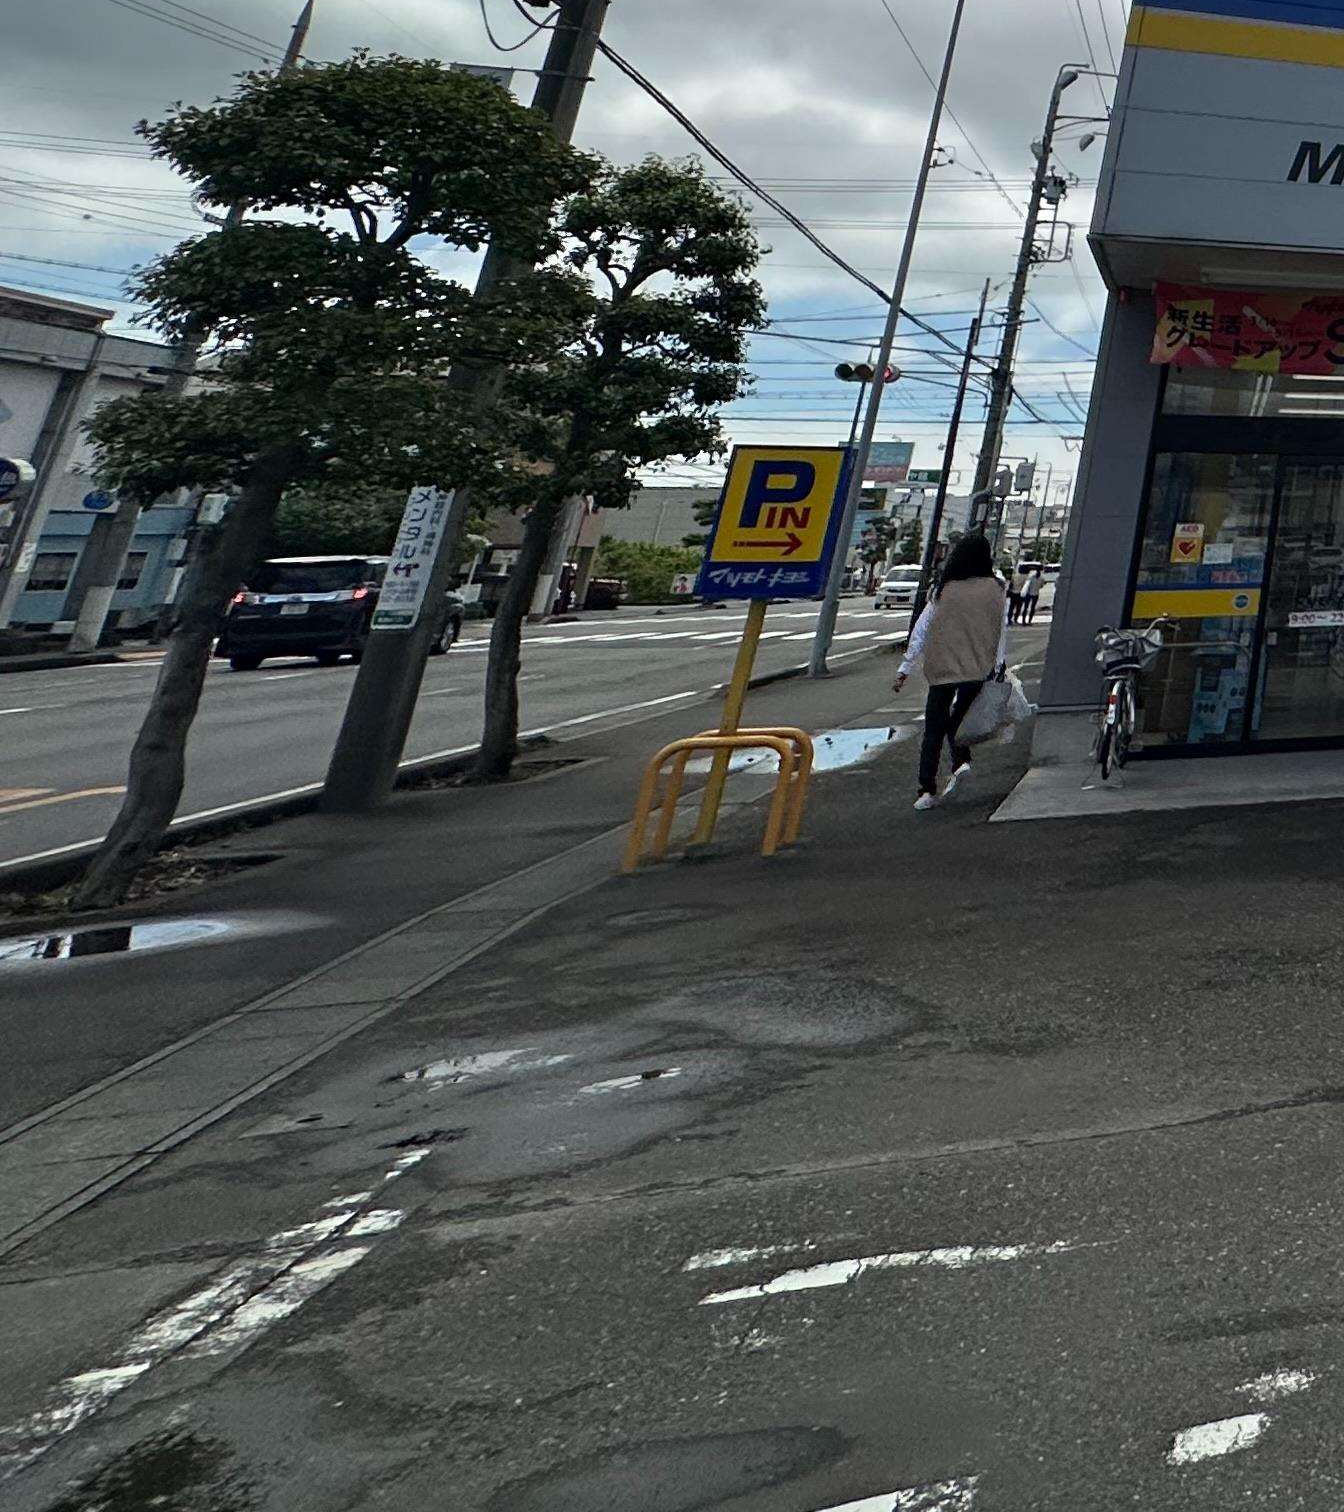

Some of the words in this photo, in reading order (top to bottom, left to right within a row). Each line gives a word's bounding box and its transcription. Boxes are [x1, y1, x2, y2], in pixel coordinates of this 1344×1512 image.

[1165, 302, 1242, 334] 新生活
[1165, 325, 1322, 361] グレードアップ
[739, 460, 816, 529] P
[764, 506, 812, 530] IN
[707, 567, 811, 588] マツモトキヨシ
